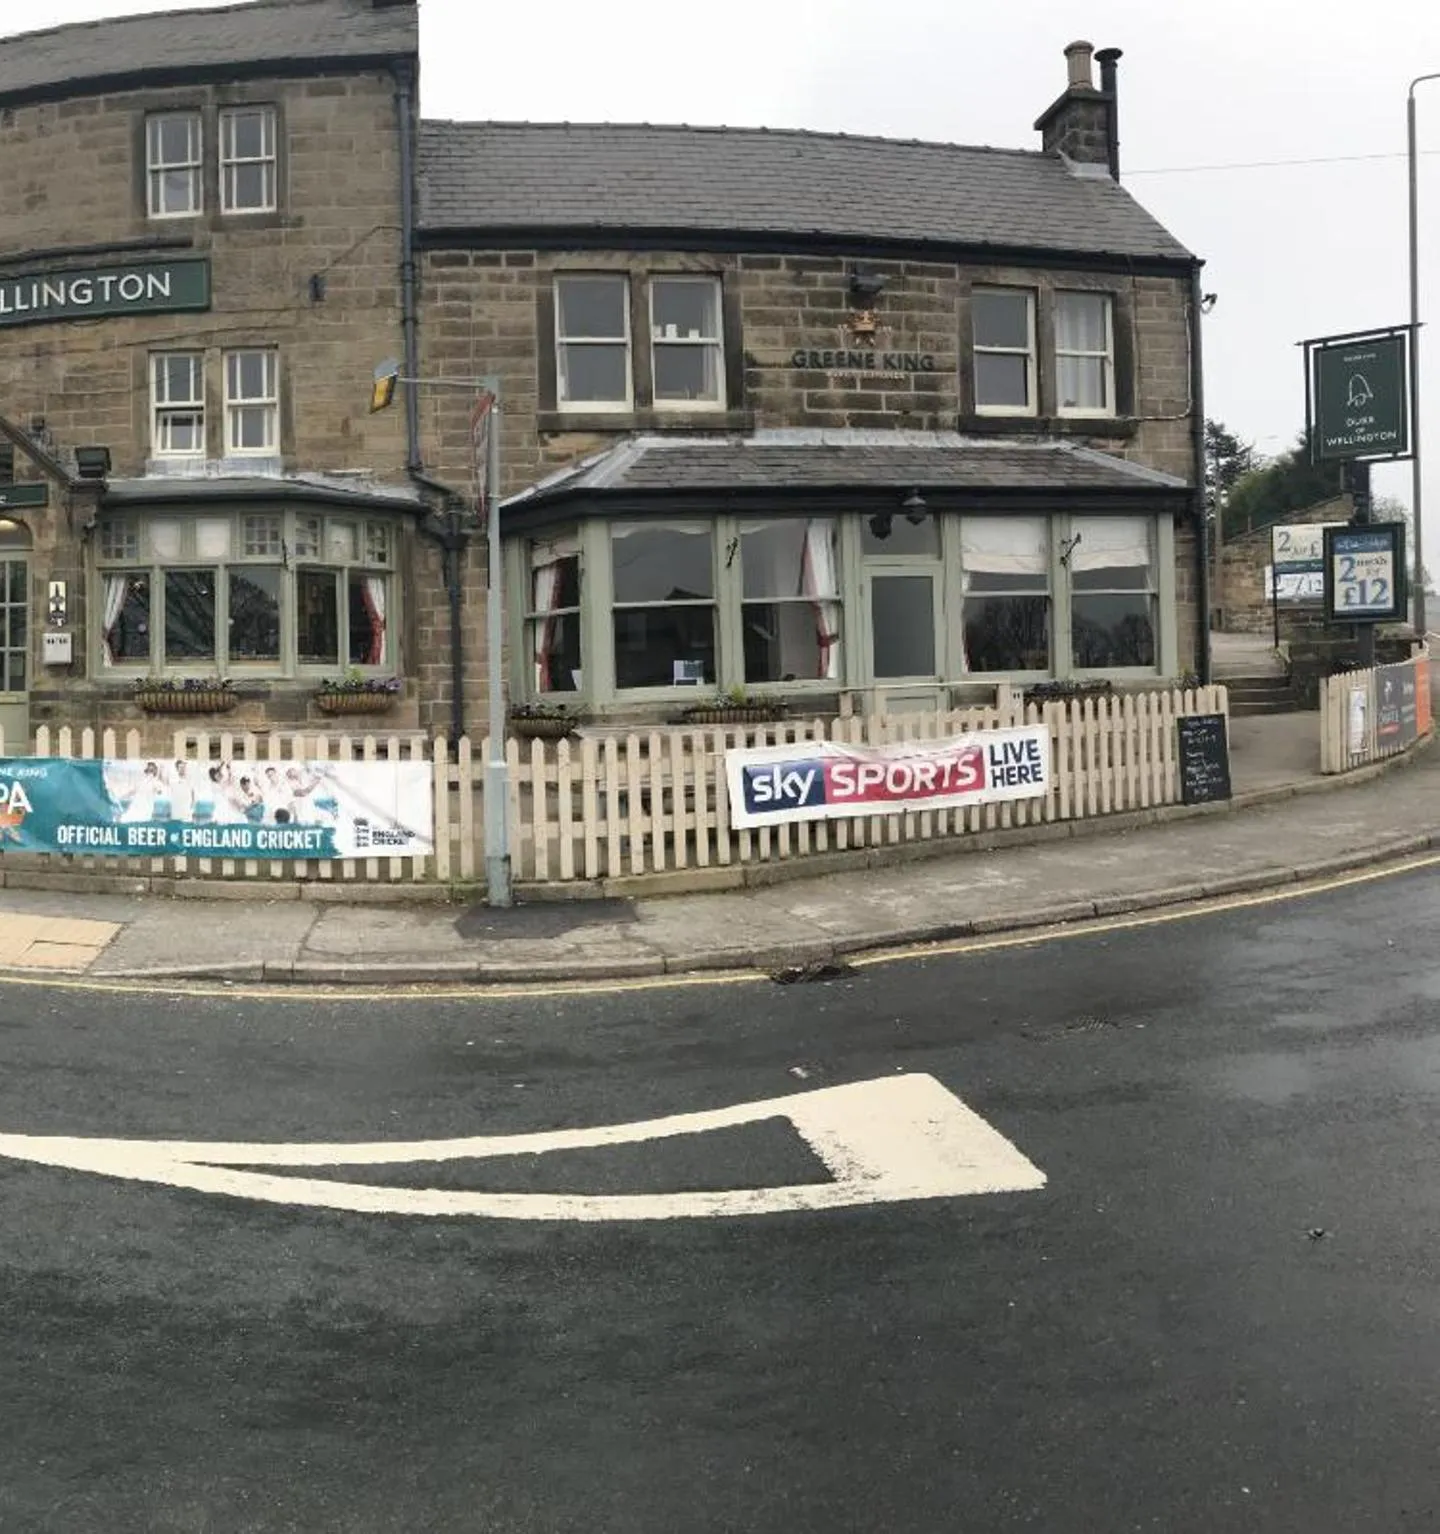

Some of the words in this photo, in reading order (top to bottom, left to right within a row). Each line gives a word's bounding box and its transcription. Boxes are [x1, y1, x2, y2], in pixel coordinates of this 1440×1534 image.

[791, 350, 875, 369] GREENE
[882, 353, 936, 371] KING
[1345, 415, 1375, 427] DUKE
[1326, 431, 1397, 446] WELLINGTON
[1277, 531, 1291, 552] 2
[1339, 556, 1357, 582] 2
[1344, 577, 1390, 606] £12
[989, 739, 1040, 765] LIVE
[753, 765, 816, 804] sky
[830, 756, 976, 797] SPORTS
[991, 763, 1044, 788] HERE
[57, 824, 122, 846] OFFICIAL
[128, 826, 166, 846] BEER
[182, 828, 252, 848] ENGLAND
[257, 829, 324, 850] CRICKET
